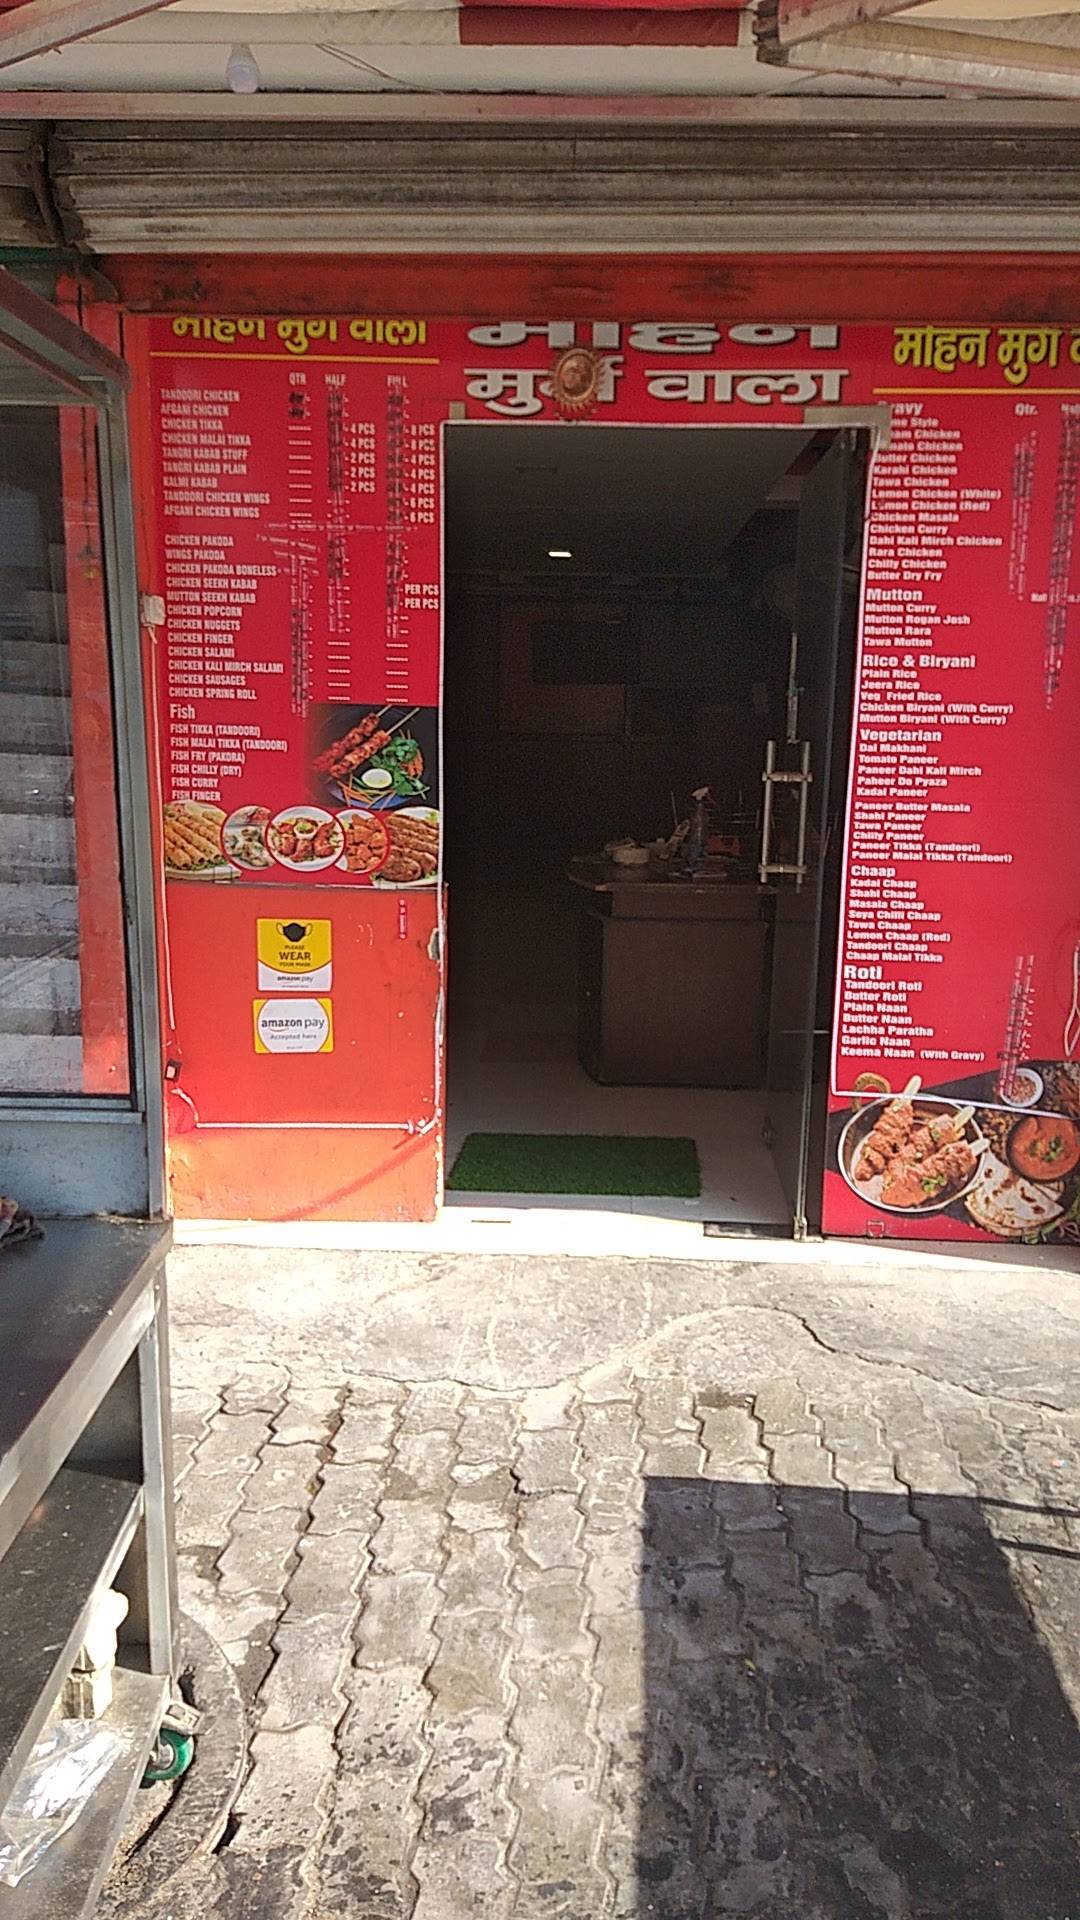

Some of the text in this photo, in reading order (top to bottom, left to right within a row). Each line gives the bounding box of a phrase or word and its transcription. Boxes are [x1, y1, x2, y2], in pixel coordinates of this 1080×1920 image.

[645, 369, 849, 403] वाला
[865, 589, 923, 602] Mutton
[865, 603, 937, 615] Mutton Curry
[864, 615, 971, 627] Mutton Rogan Josh
[863, 626, 932, 636] Mutton Rara
[863, 637, 934, 647] Tawa Mutton
[862, 654, 976, 671] Rice & Biryani
[861, 669, 918, 679] Plain Rice
[861, 680, 921, 690] Jeera Rice
[860, 691, 942, 703] Veg Fried Rice
[860, 703, 1014, 716] Chicken Biryani (With Curry)
[859, 729, 943, 744] Vegetarian
[858, 744, 927, 754] Dal Makhani
[858, 754, 939, 765] Tomato Paneer
[857, 765, 982, 776] Paneer Dahi Kali Mirch
[897, 777, 912, 786] Do
[914, 777, 948, 789] Pyaza
[856, 787, 929, 797] Kadai Paneer
[854, 802, 972, 813] Paneer Butter Masala
[853, 812, 927, 821] Shahi Paneer
[852, 831, 925, 842] Chilly Paneer
[852, 842, 981, 853] Paneer Tikka (Tandoori)
[852, 851, 1013, 864] Paneer Malai Tikka (Tandoori)
[850, 865, 896, 881] Chaap
[849, 878, 918, 891] Kadai Chaap
[848, 900, 925, 912] Masala Chaap
[848, 910, 942, 924] Soya Chilli Chaap
[847, 921, 912, 933] Tawa Chaap
[847, 931, 952, 943] Lemon Chaap (Red)
[846, 941, 929, 954] Tandoori Chaap
[279, 952, 311, 960] WEAR
[845, 952, 944, 964] Chaap Malai Tikka
[844, 965, 883, 980] Roti
[844, 992, 907, 1002] Butter Roti
[843, 1002, 908, 1013] Plain Naan
[262, 1019, 325, 1029] amazon pay
[842, 1025, 935, 1037] Lachha Paratha
[841, 1036, 912, 1047] Garlic Naan
[840, 1047, 985, 1063] Keema Naan (With Gravy)
